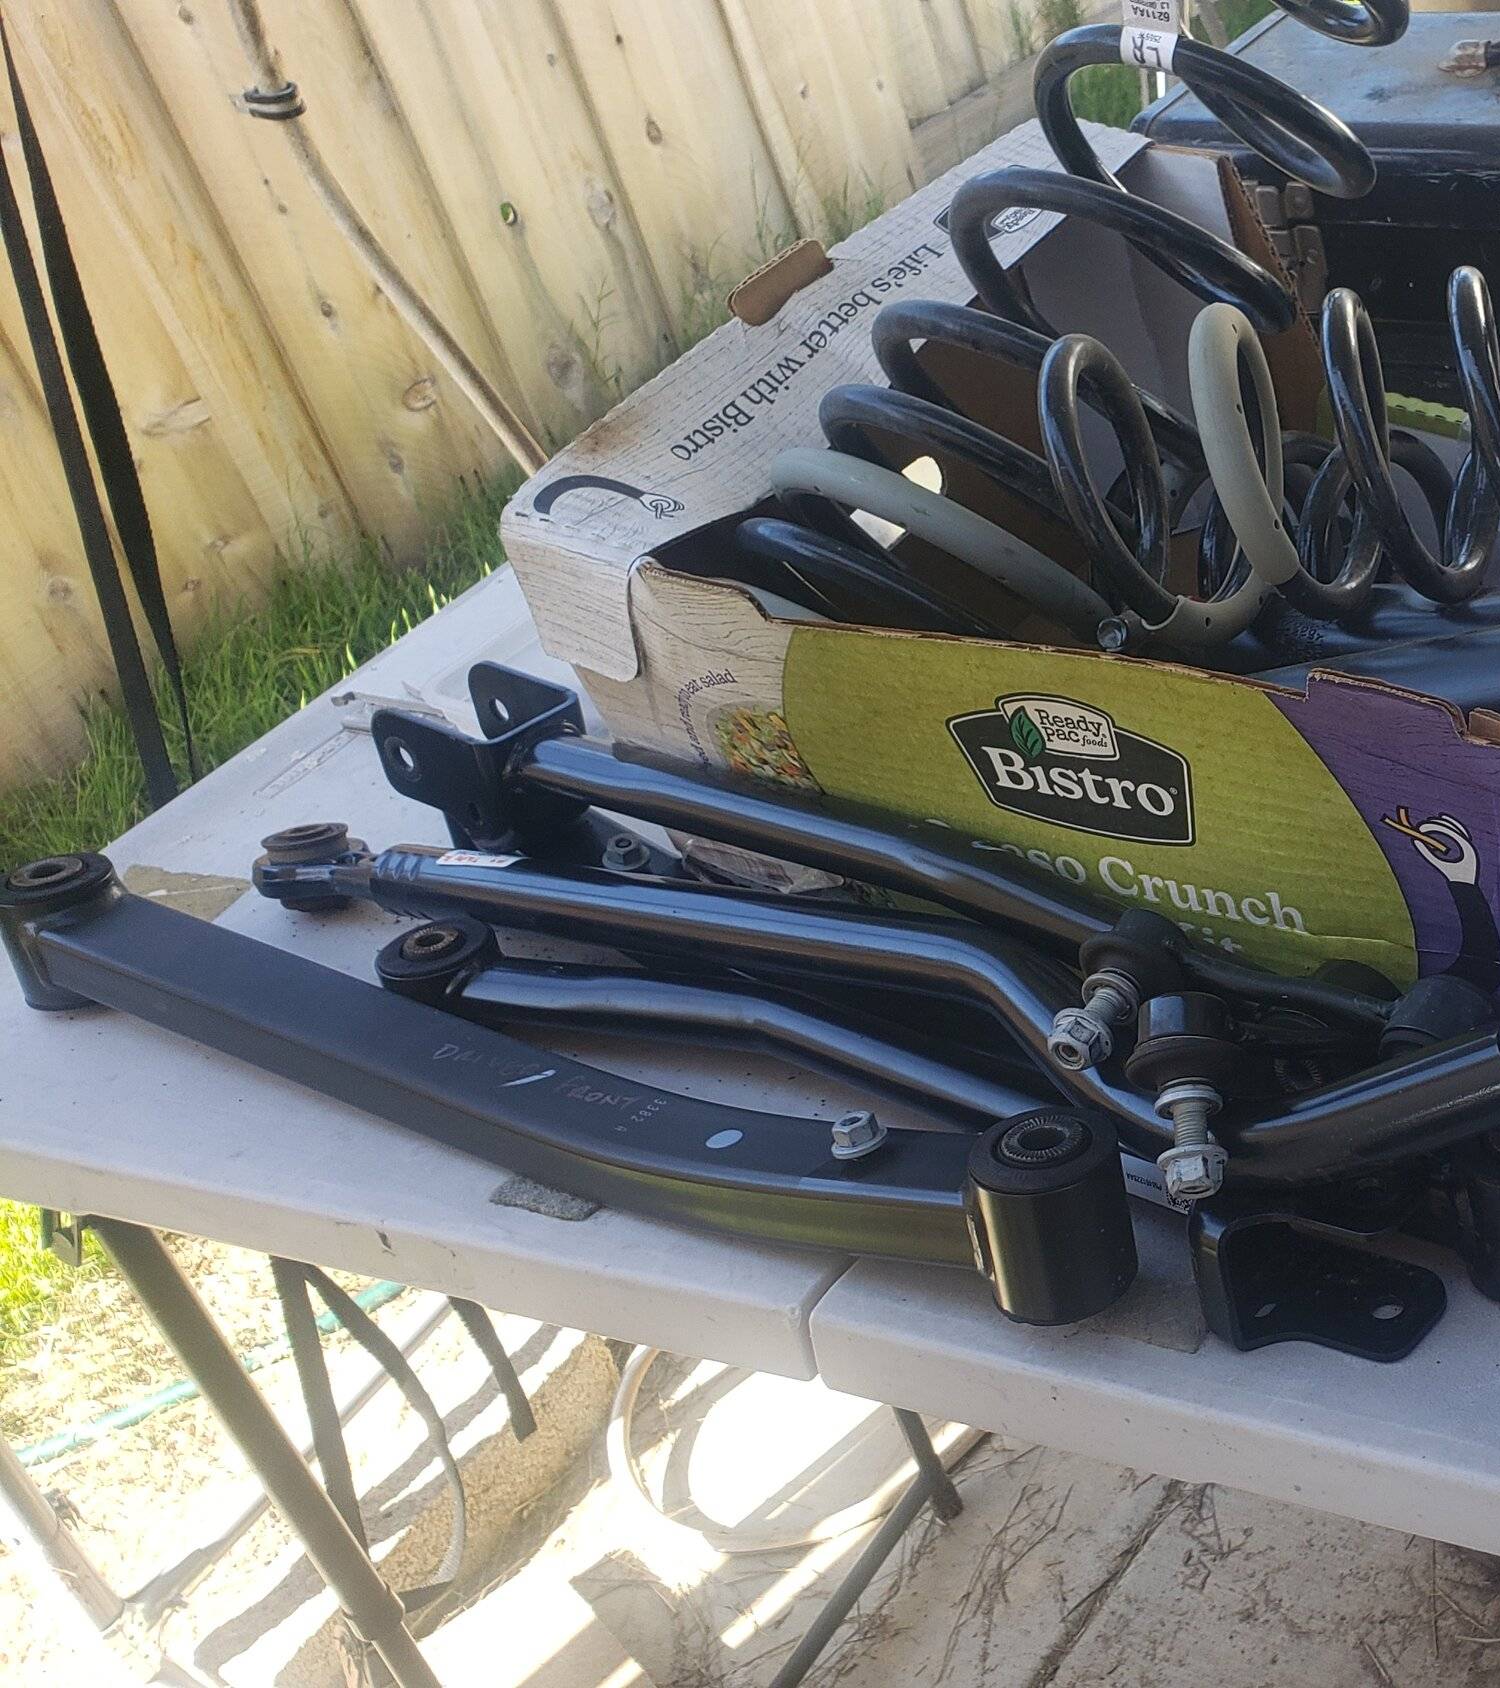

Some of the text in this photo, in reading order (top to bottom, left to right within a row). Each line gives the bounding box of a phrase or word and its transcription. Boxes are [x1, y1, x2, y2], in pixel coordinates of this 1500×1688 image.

[670, 243, 944, 461] Life's better with Bistro
[700, 668, 738, 688] salad
[1034, 709, 1103, 737] Ready
[1081, 736, 1108, 748] foods
[981, 746, 1175, 816] Bistro
[1098, 856, 1309, 935] Crunch
